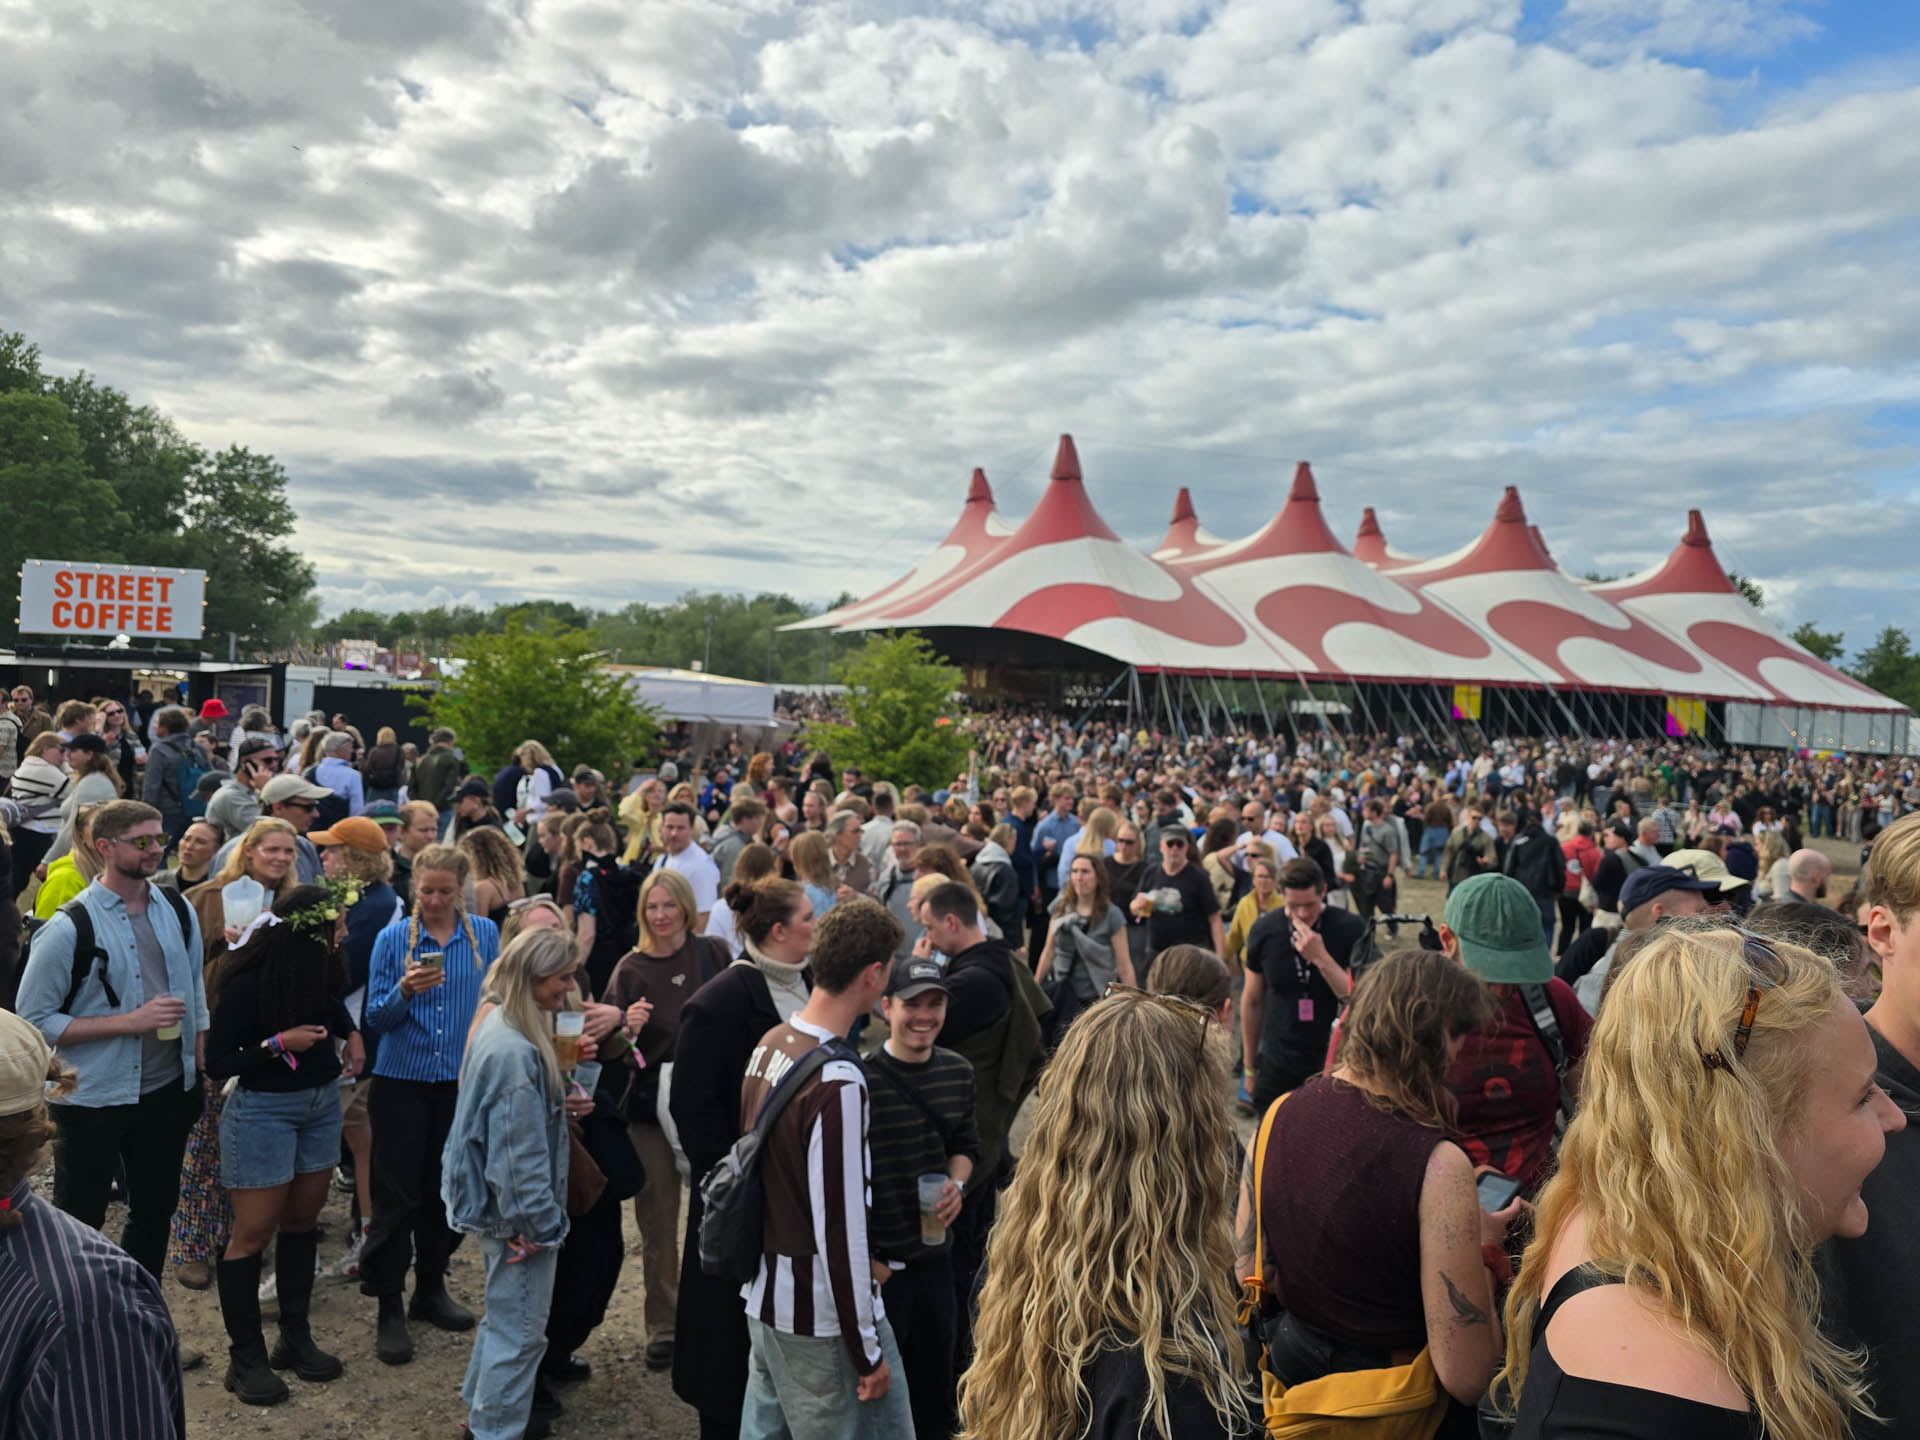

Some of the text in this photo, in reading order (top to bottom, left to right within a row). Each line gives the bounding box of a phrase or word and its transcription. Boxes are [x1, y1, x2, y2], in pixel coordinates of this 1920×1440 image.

[53, 571, 174, 603] STREET
[52, 601, 173, 632] COFFEE
[764, 1049, 795, 1087] PAU
